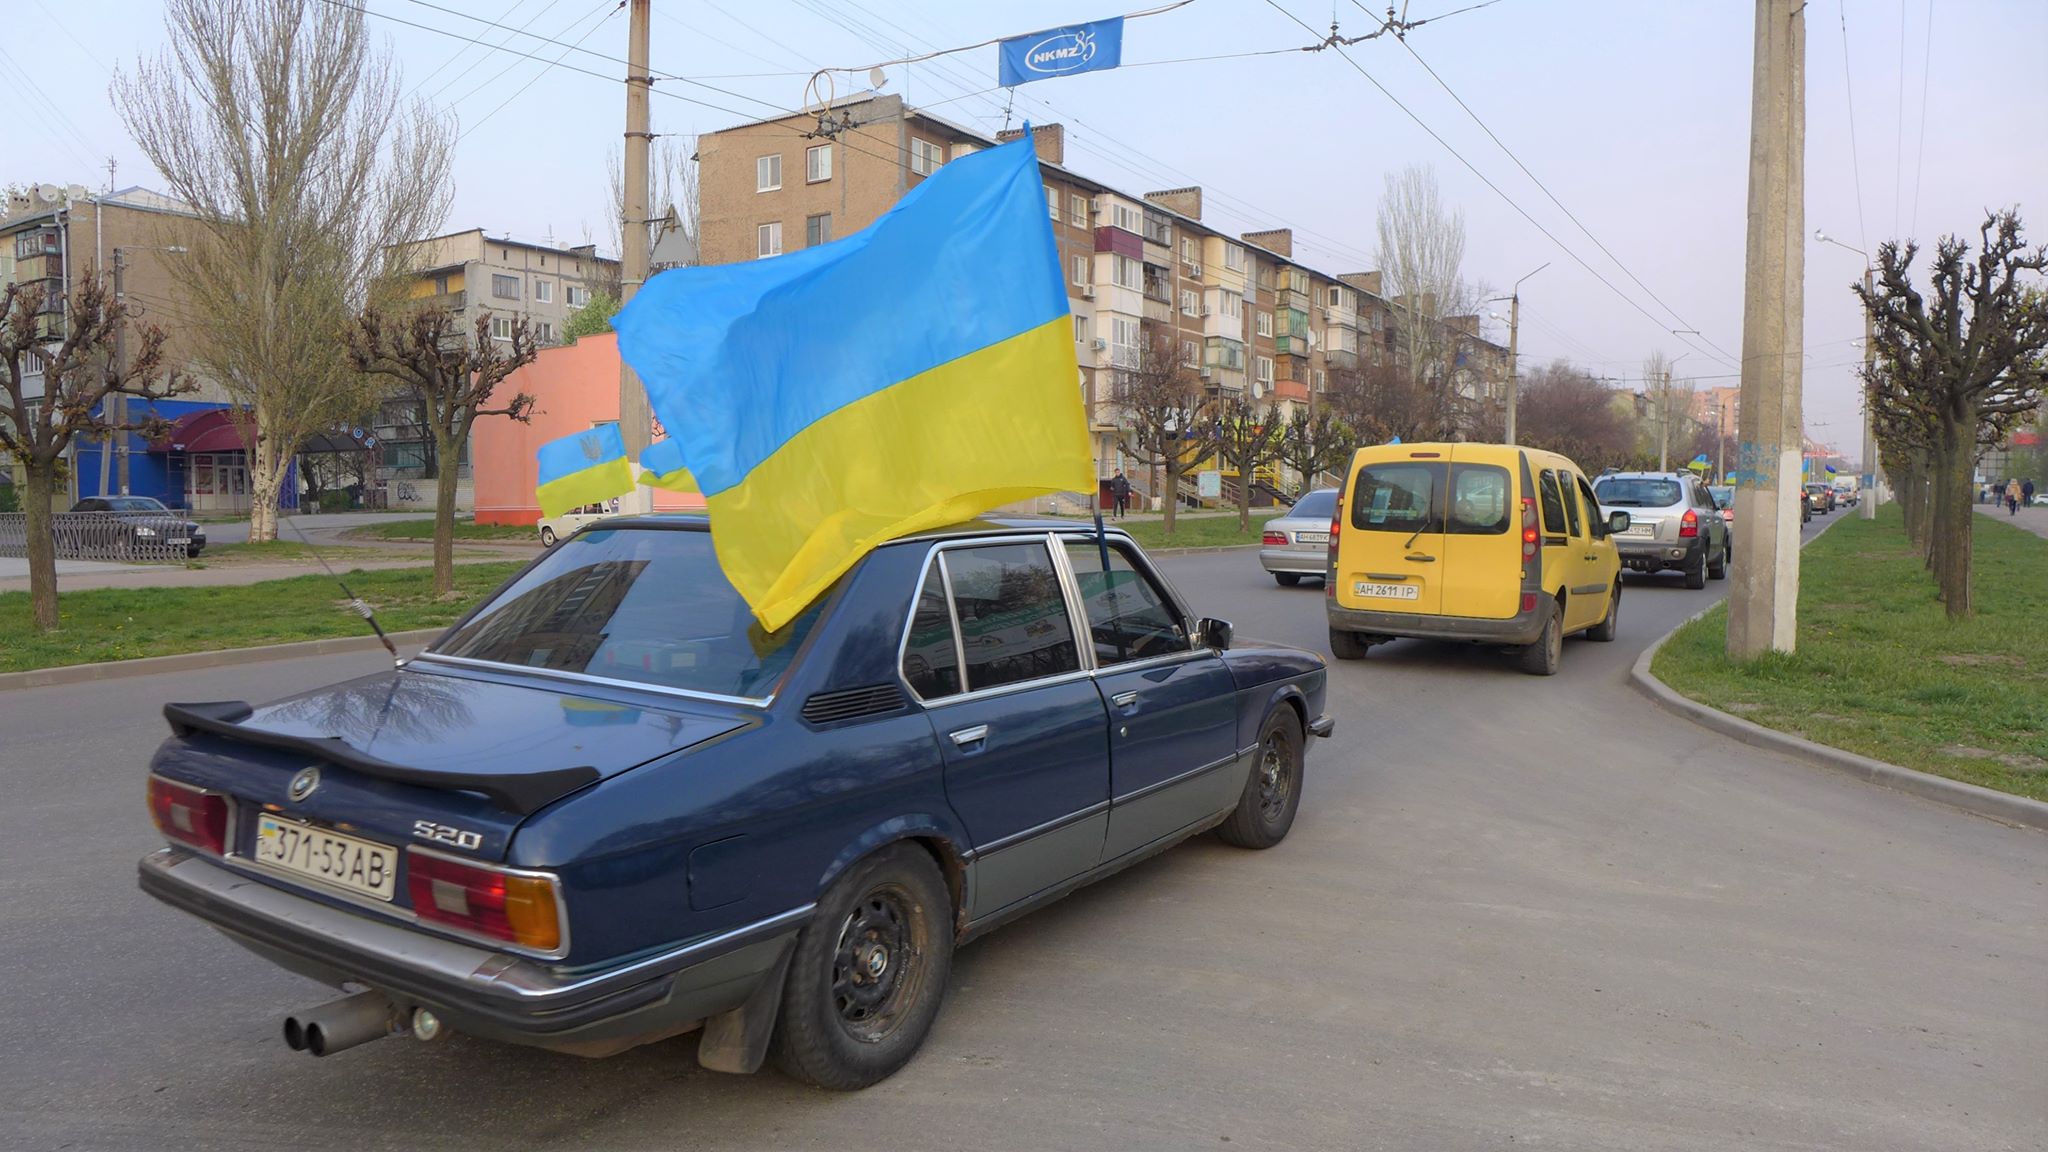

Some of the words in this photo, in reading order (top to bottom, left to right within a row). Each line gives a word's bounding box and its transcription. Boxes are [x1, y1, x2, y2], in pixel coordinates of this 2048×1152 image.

[1034, 46, 1077, 63] NKMZ
[1075, 30, 1096, 61] 85
[1360, 584, 1374, 595] AH
[1376, 585, 1398, 596] 2611
[1401, 587, 1415, 597] IP
[413, 820, 484, 850] 520
